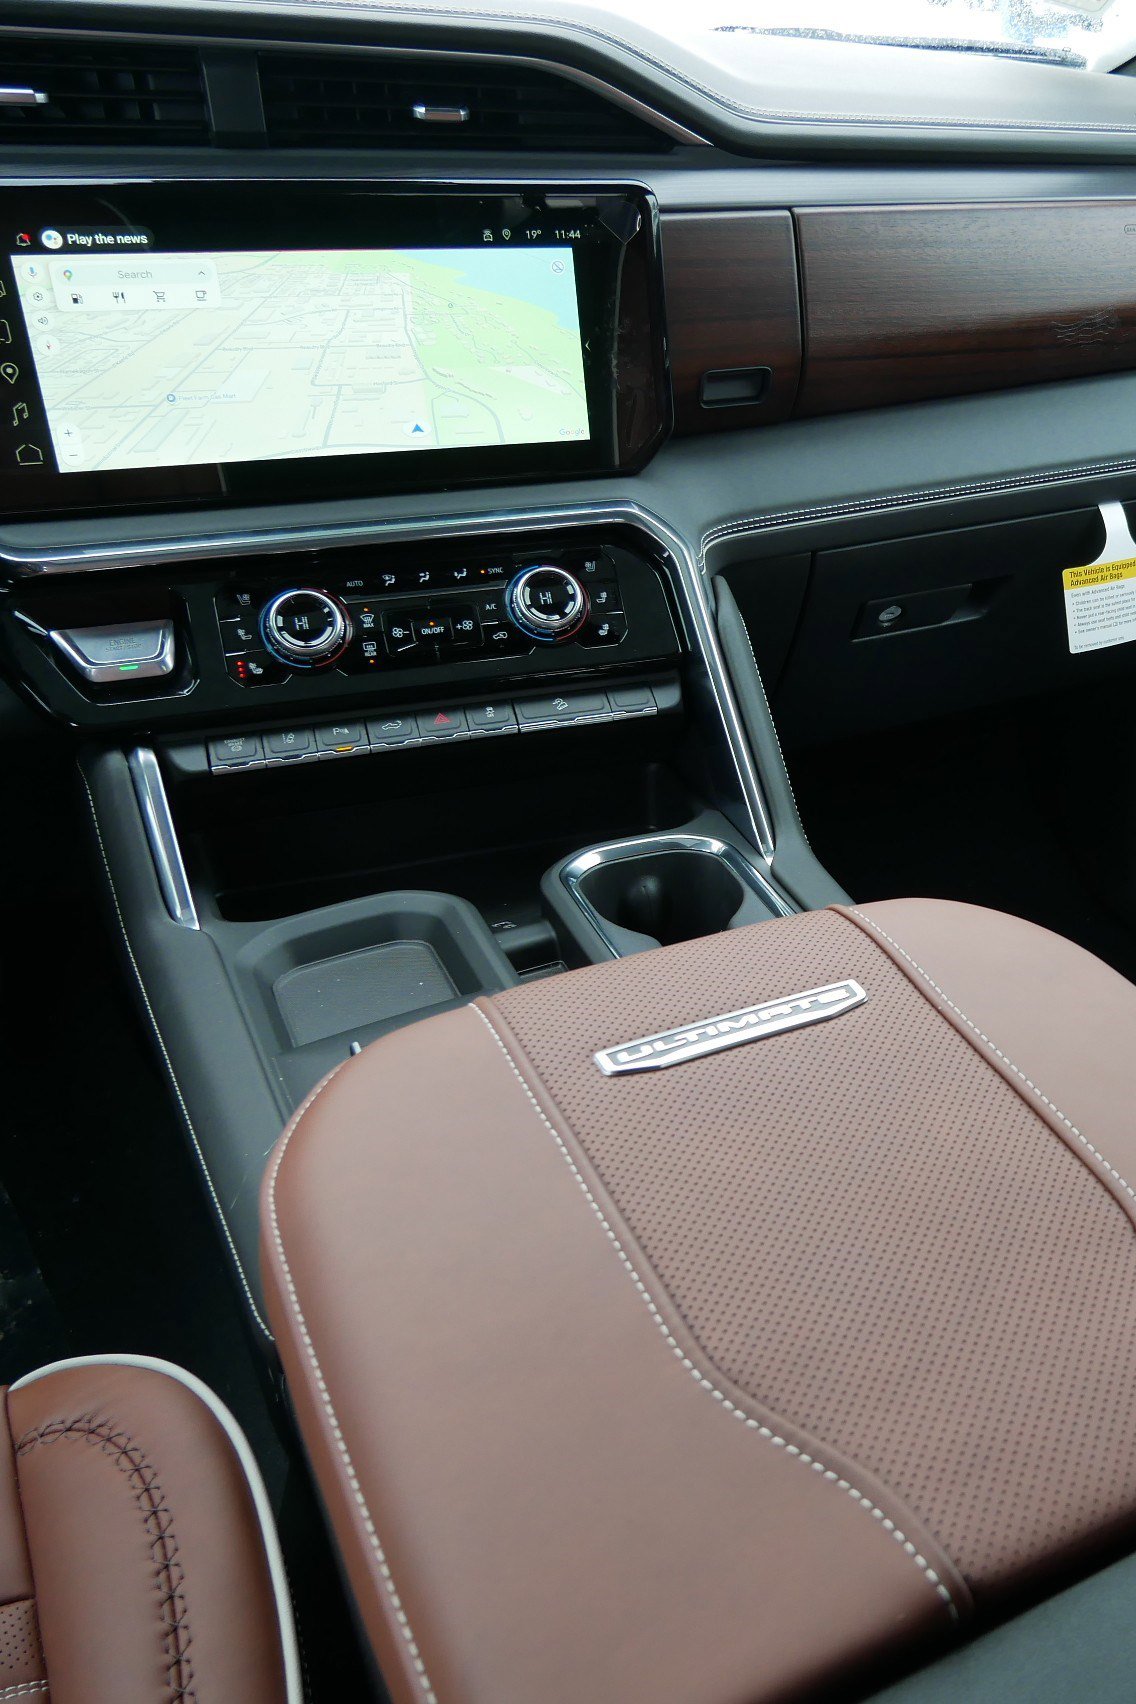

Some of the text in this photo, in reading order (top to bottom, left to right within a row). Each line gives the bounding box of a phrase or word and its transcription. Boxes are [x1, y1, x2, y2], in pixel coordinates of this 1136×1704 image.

[555, 230, 580, 239] 11:44
[67, 233, 148, 246] Play the news
[118, 270, 153, 279] Search
[487, 567, 504, 575] SYNC
[1069, 571, 1083, 579] This
[1083, 566, 1105, 576] Vehicle
[1111, 559, 1136, 571] Equipped
[1070, 571, 1123, 587] Advanced Air Bags
[346, 580, 364, 588] AUTO
[485, 603, 498, 611] A/C
[421, 626, 445, 635] ON/OFF
[616, 988, 850, 1062] ULTIMATE
